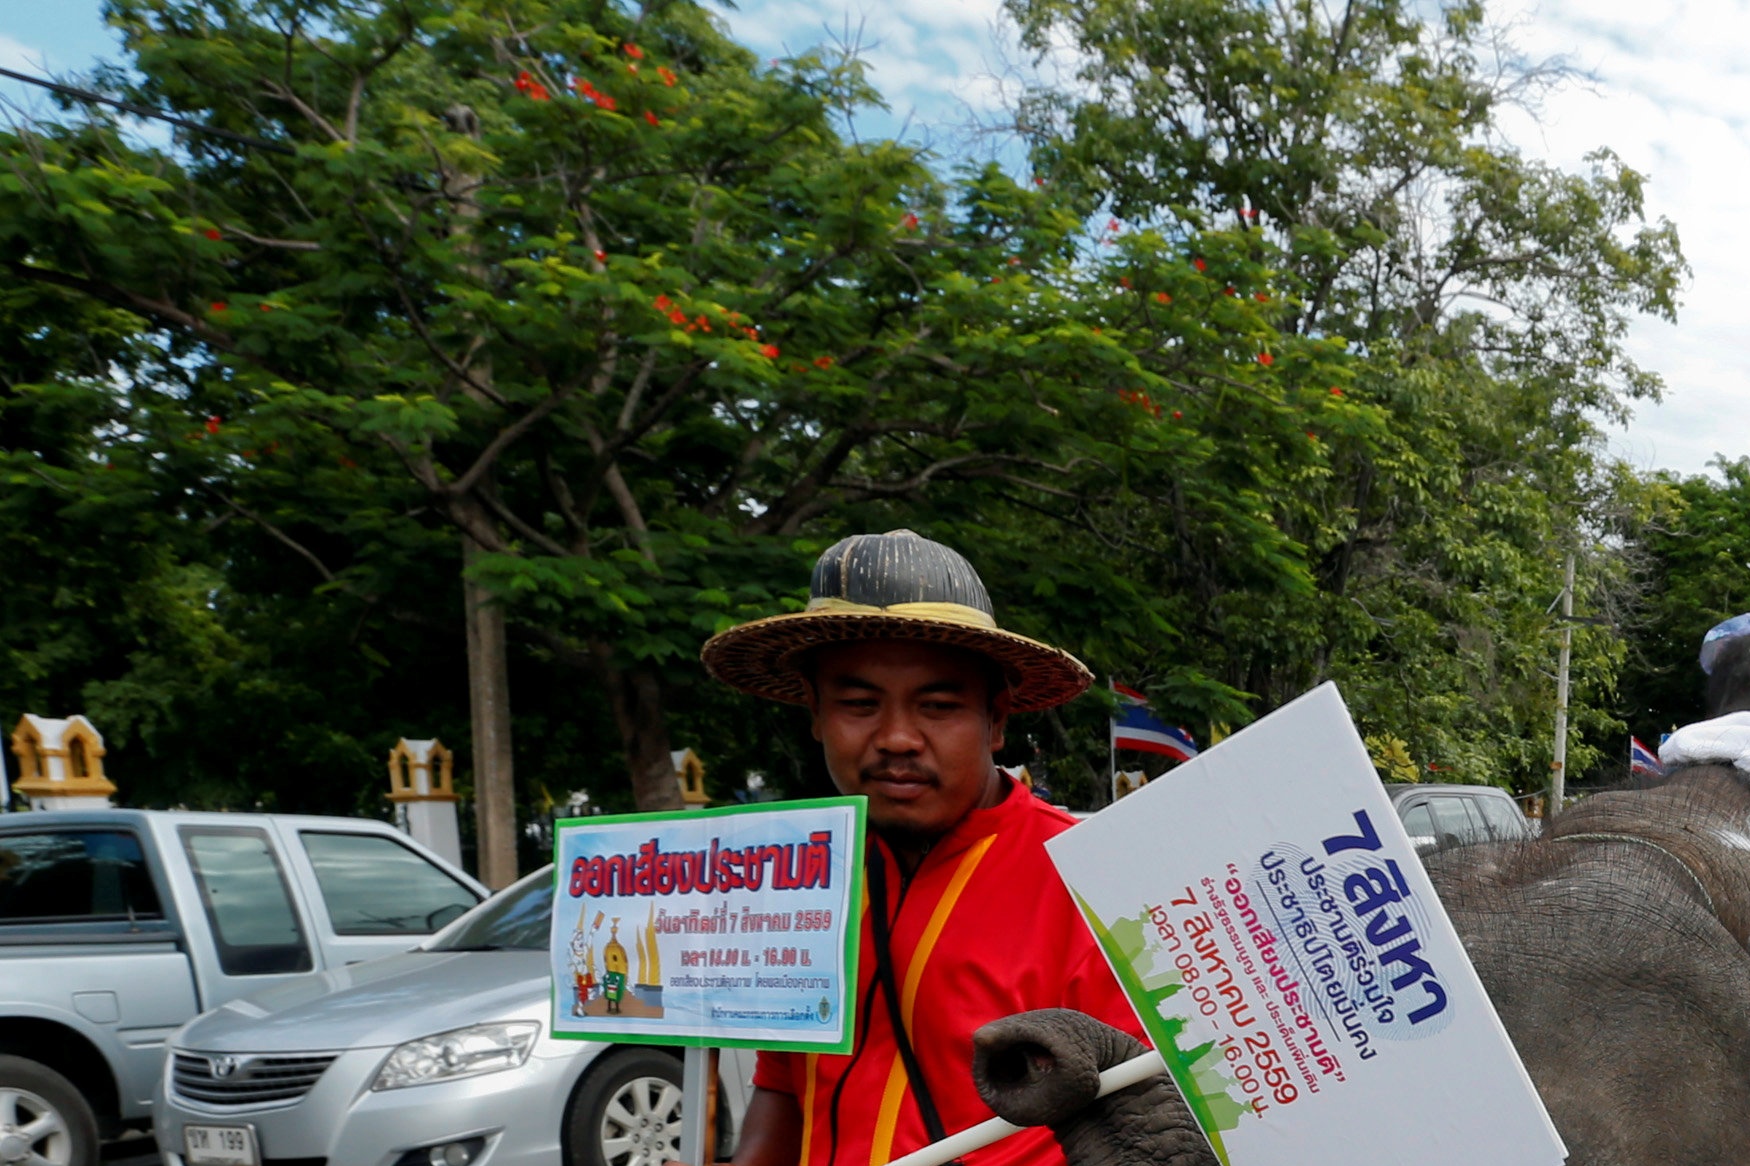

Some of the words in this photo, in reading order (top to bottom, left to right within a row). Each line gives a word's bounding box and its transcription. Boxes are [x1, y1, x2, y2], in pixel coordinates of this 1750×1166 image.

[569, 830, 832, 897] ออกเสียงประชามติ
[1170, 886, 1199, 908] 7
[729, 913, 738, 934] 7
[740, 906, 792, 933] สิงหาคม
[793, 910, 832, 932] 2559
[763, 947, 797, 967] 16.00
[1260, 851, 1378, 1061] ประชาธิปไตยมั่นคง
[1299, 857, 1395, 1024] ประชามติร่วมใจ
[1182, 911, 1257, 1028] สิงหาคม
[1201, 877, 1257, 976] ร่างรัฐธรรมนูญ
[1251, 976, 1269, 999] และ
[1265, 1001, 1321, 1094] ประเด็นเพิ่มเติม
[1148, 905, 1183, 953] เวลา
[1174, 953, 1219, 1017] 08.00
[1217, 1033, 1263, 1095] 16.00
[1250, 1096, 1271, 1120] น.
[1243, 1031, 1299, 1106] 2559
[219, 1130, 244, 1150] 199
